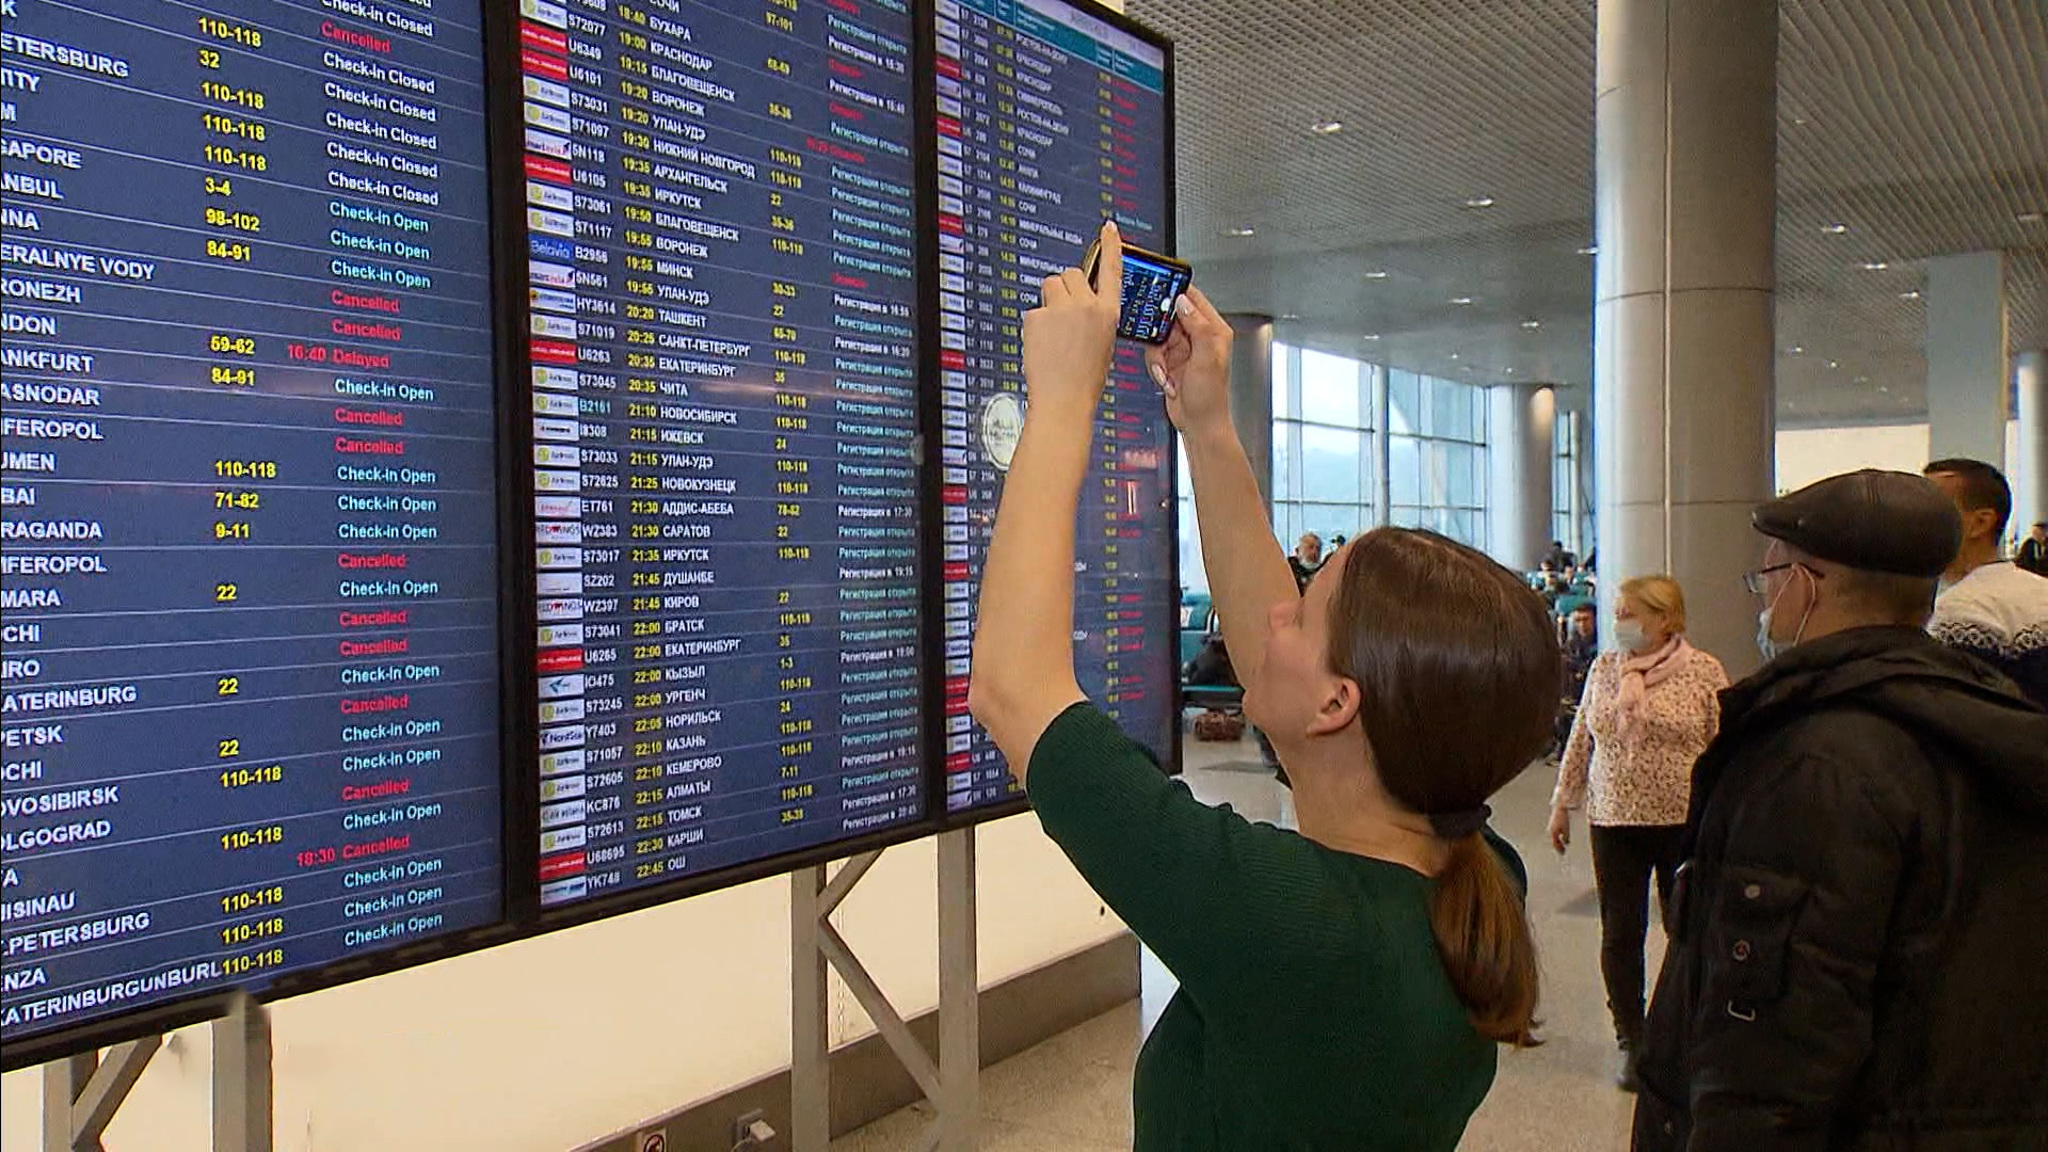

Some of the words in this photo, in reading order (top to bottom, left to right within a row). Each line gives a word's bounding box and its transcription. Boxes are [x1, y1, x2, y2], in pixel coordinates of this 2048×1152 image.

[199, 17, 261, 48] 110-118
[321, 21, 391, 52] Cancelled
[199, 51, 219, 69] 32
[323, 52, 386, 80] Check-in
[388, 69, 435, 94] Closed
[201, 82, 264, 109] 110-118
[325, 82, 387, 110] Check-in
[389, 99, 436, 122] Closed
[202, 114, 265, 141] 110-118
[204, 145, 267, 171] 110-118
[327, 141, 389, 167] Check-in
[391, 157, 438, 178] Closed
[205, 178, 231, 196] 3-4
[206, 209, 260, 231] 98-102
[330, 202, 393, 227] Check-in
[395, 217, 429, 233] Open
[1, 243, 96, 273] ERALNYE
[100, 256, 155, 280] VODY
[206, 240, 250, 262] 84-91
[332, 260, 395, 283] Check-in
[397, 273, 431, 290] Open
[331, 290, 400, 312] Cancelled
[211, 367, 255, 386] 84-91
[335, 379, 397, 399] Check-in
[400, 386, 434, 401] Open
[336, 407, 403, 425] Cancelled
[1, 417, 104, 439] FEROPOL
[215, 461, 276, 479] 110-118
[215, 492, 258, 509] 71-82
[338, 496, 398, 511] Check-in
[402, 497, 436, 513] Open
[1, 522, 103, 539] RAGANDA
[215, 523, 249, 539] 9-11
[338, 554, 406, 568] Cancelled
[1, 589, 61, 607] MARA
[216, 585, 237, 601] 22
[340, 581, 399, 596] Check-in
[403, 580, 438, 596] Open
[339, 610, 407, 626] Cancelled
[1, 625, 40, 642] CHI
[1, 660, 40, 678] IRO
[342, 668, 401, 684] Check-in
[405, 664, 440, 681] Open
[218, 678, 238, 695] 22
[1, 686, 137, 712] ATERINBURG
[341, 695, 408, 714] Cancelled
[219, 740, 239, 757] 22
[343, 753, 402, 772] Check-in
[405, 747, 441, 765] Open
[220, 767, 281, 788] 110-118
[221, 828, 282, 850] 110-118
[297, 848, 335, 866] 18:30
[342, 835, 409, 860] Cancelled
[221, 888, 282, 913] 110-118
[344, 894, 404, 918] Check-in
[407, 886, 442, 905] Open
[221, 919, 282, 945] 110-118
[345, 924, 404, 947] Check-in
[407, 913, 443, 933] Open
[222, 950, 283, 976] 110-118
